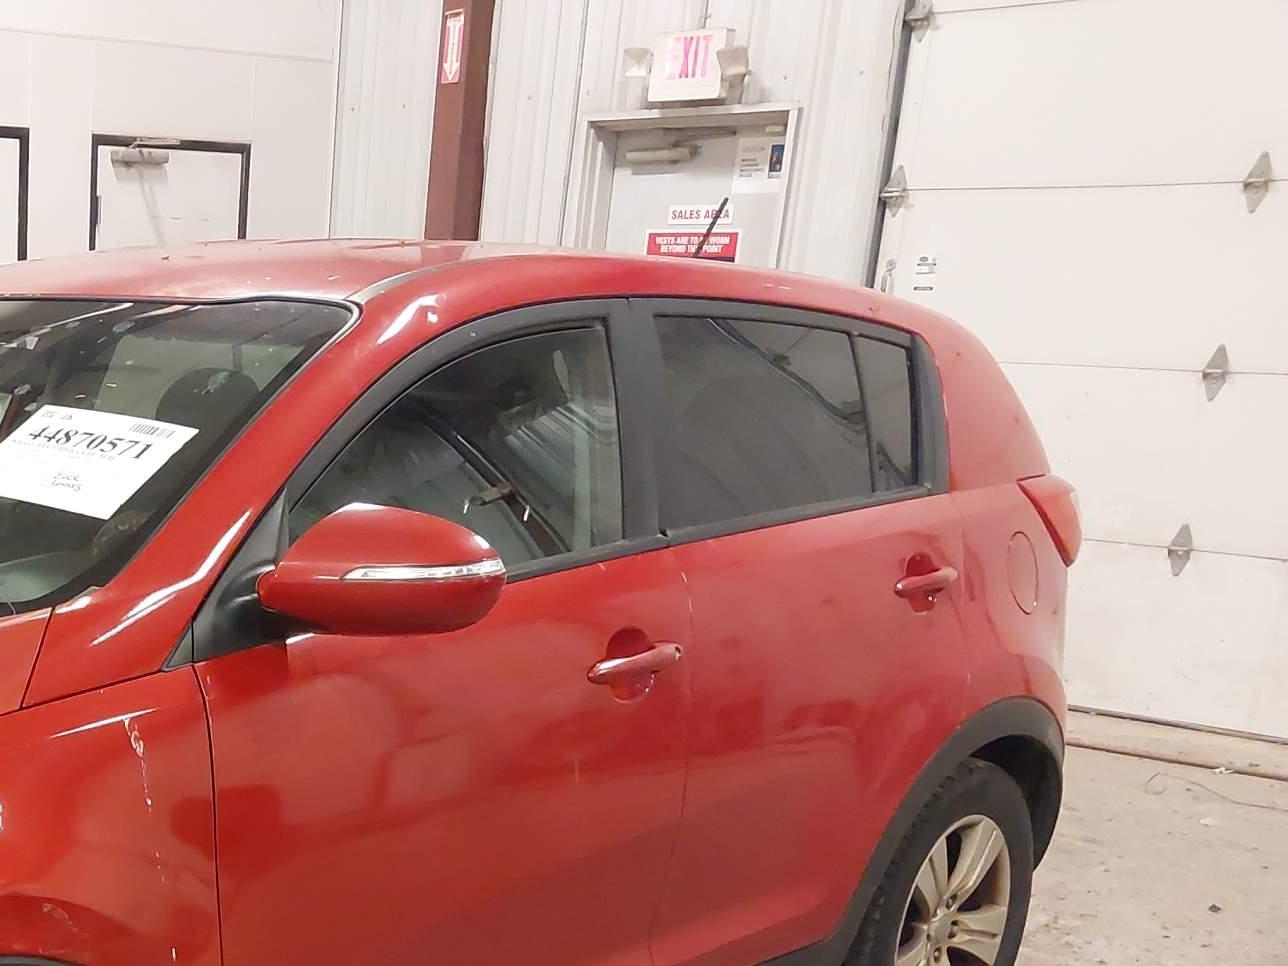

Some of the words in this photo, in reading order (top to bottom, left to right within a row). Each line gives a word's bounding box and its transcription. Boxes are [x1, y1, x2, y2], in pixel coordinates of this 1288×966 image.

[664, 35, 713, 79] EXIT
[671, 209, 702, 220] SALES
[704, 208, 730, 219] ARA
[655, 236, 675, 245] VESTS
[660, 244, 686, 253] BEYOND
[702, 245, 723, 253] POINT
[29, 425, 153, 459] 44870571
